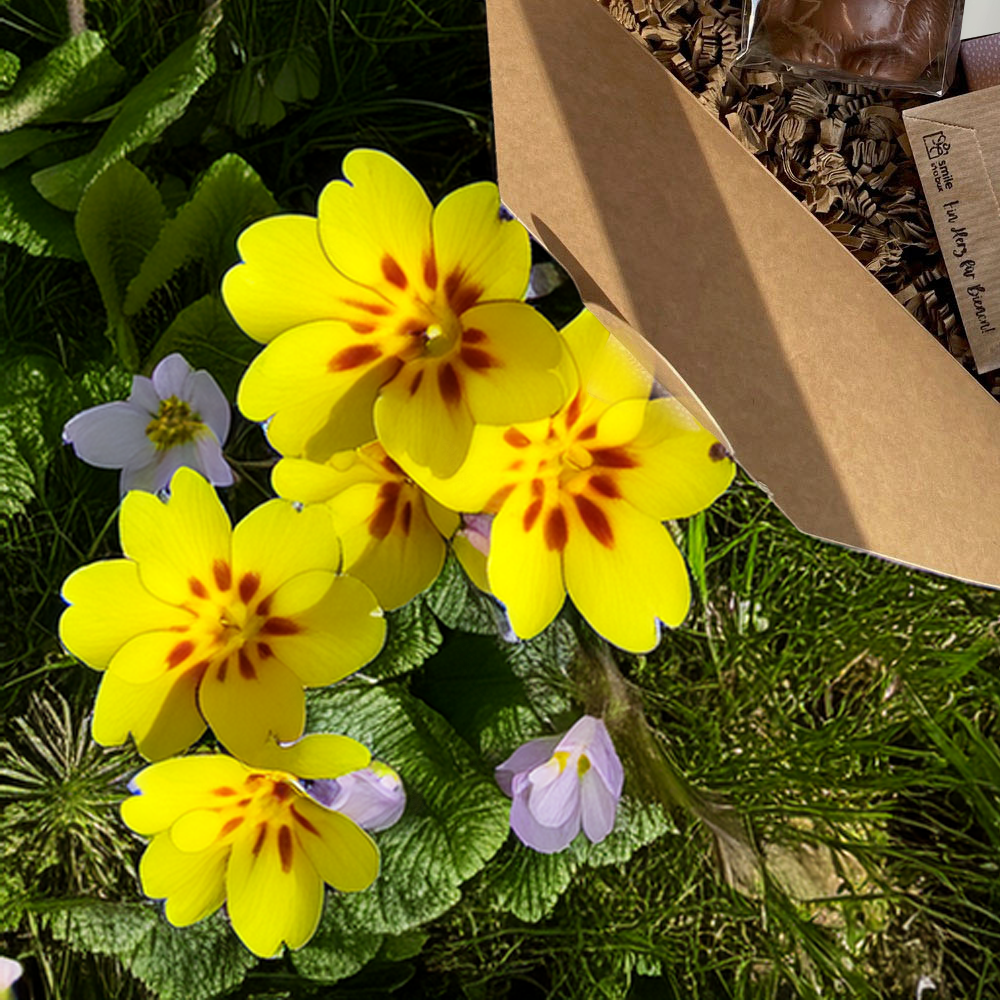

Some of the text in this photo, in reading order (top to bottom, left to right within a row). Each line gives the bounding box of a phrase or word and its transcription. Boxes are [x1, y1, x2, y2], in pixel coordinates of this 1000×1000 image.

[938, 159, 953, 190] smile
[943, 199, 996, 335] Ein Herz für Bienen!
